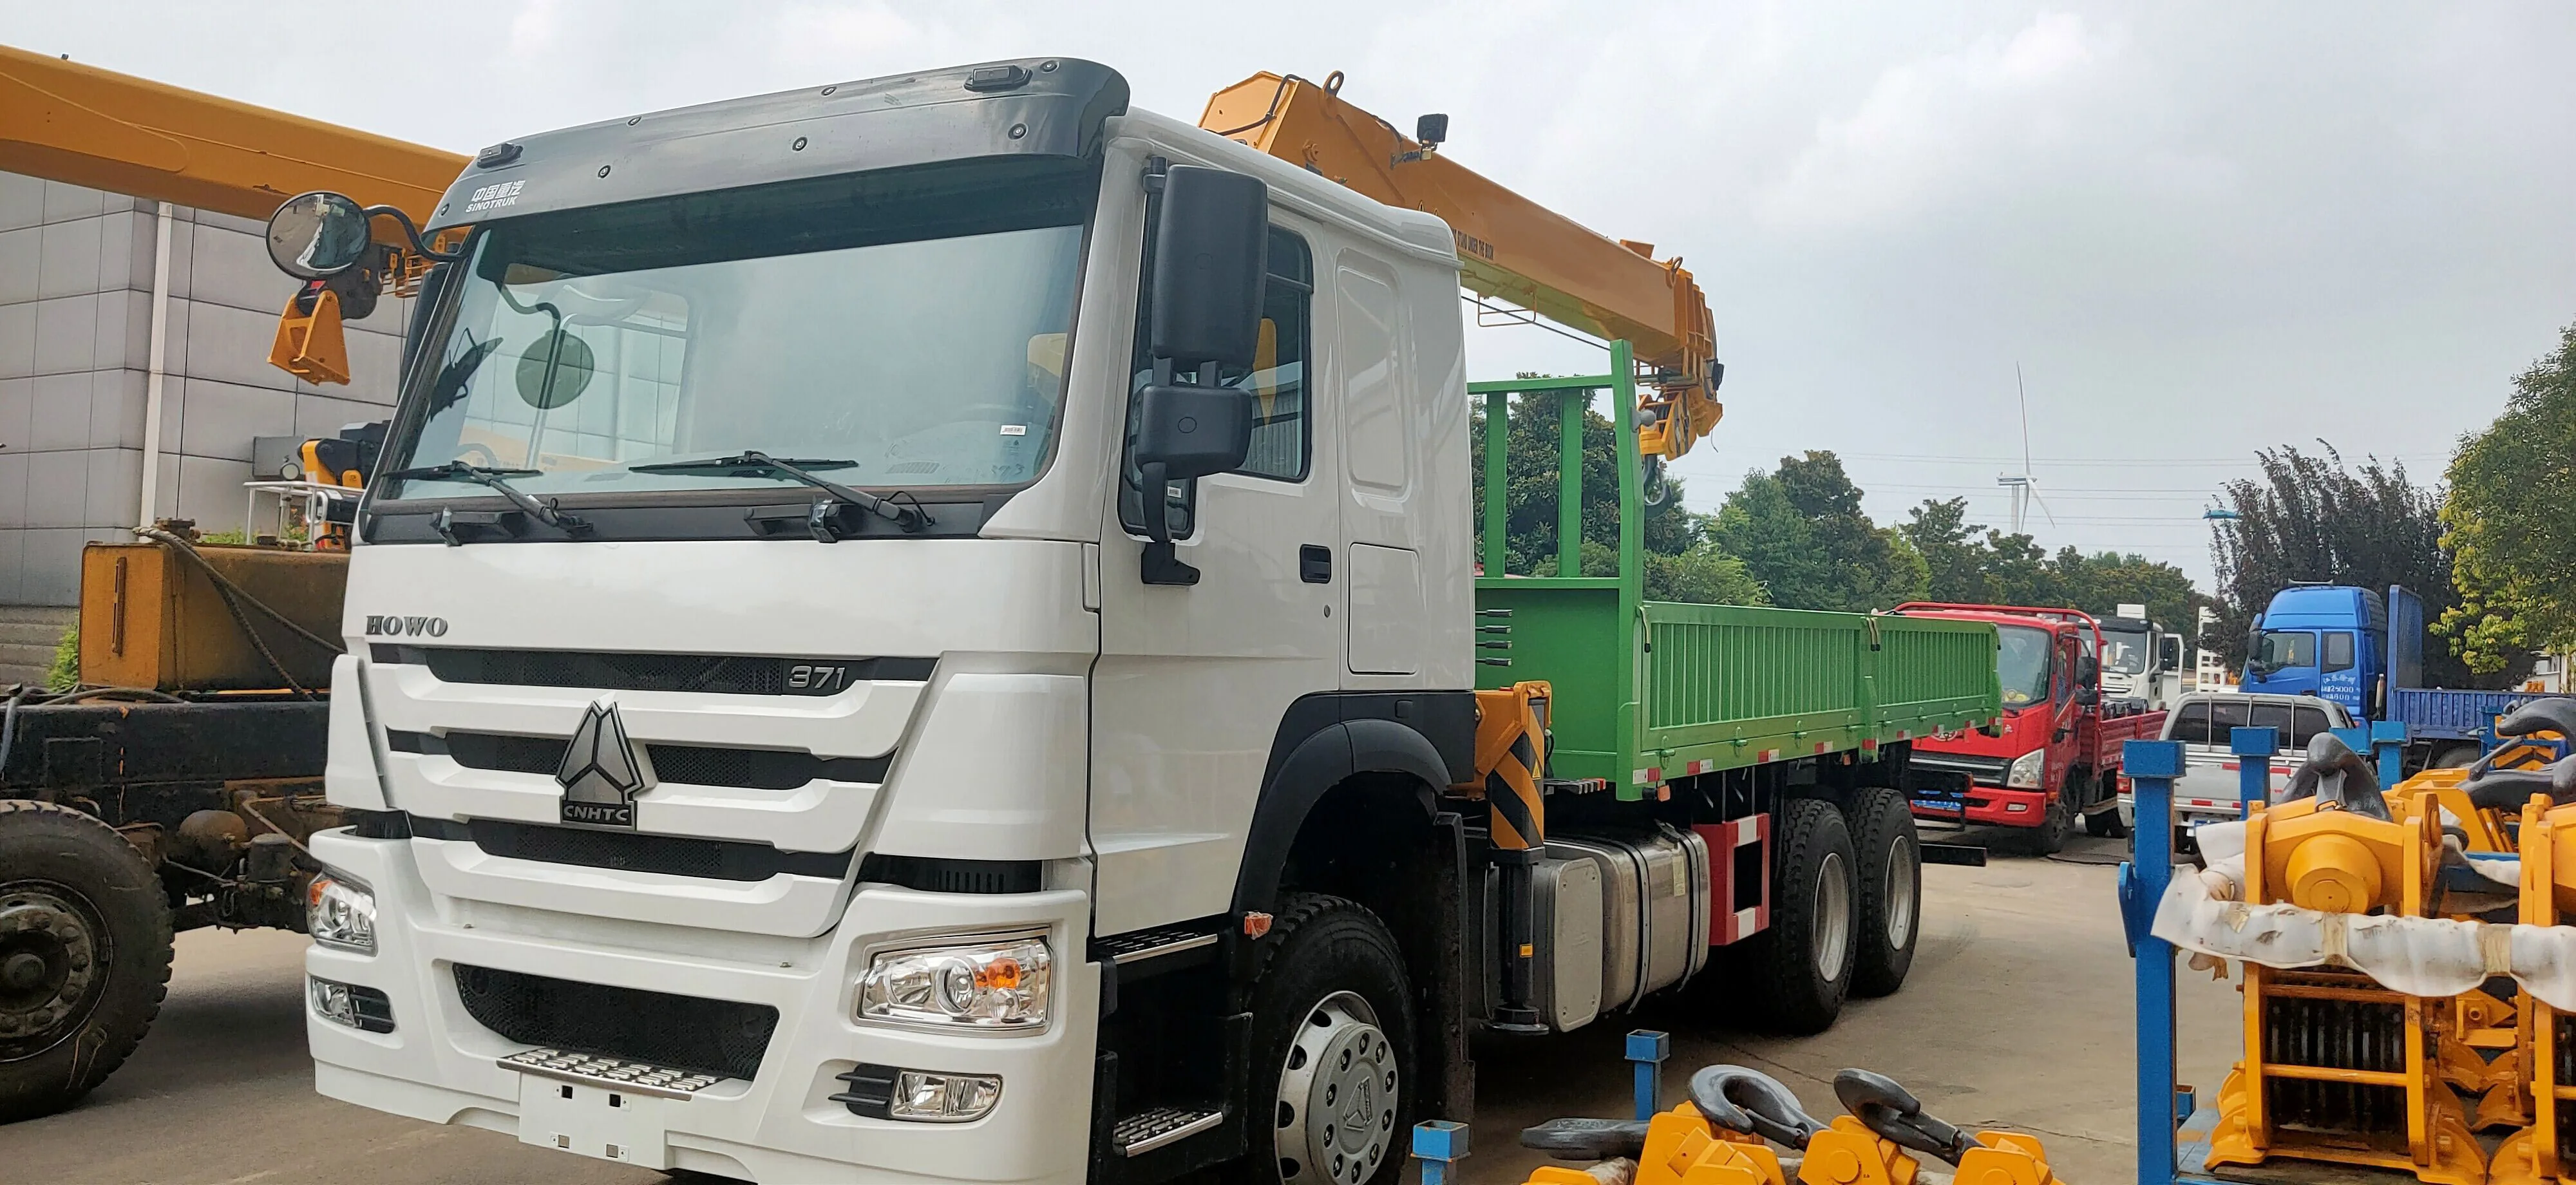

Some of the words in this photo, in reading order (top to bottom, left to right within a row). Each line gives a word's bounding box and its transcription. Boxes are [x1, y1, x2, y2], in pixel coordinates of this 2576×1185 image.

[471, 180, 526, 202] 中国重汽
[466, 196, 517, 213] SINOTRUK
[365, 616, 448, 637] HOWO
[788, 665, 846, 689] 371
[564, 805, 629, 822] CNHTC
